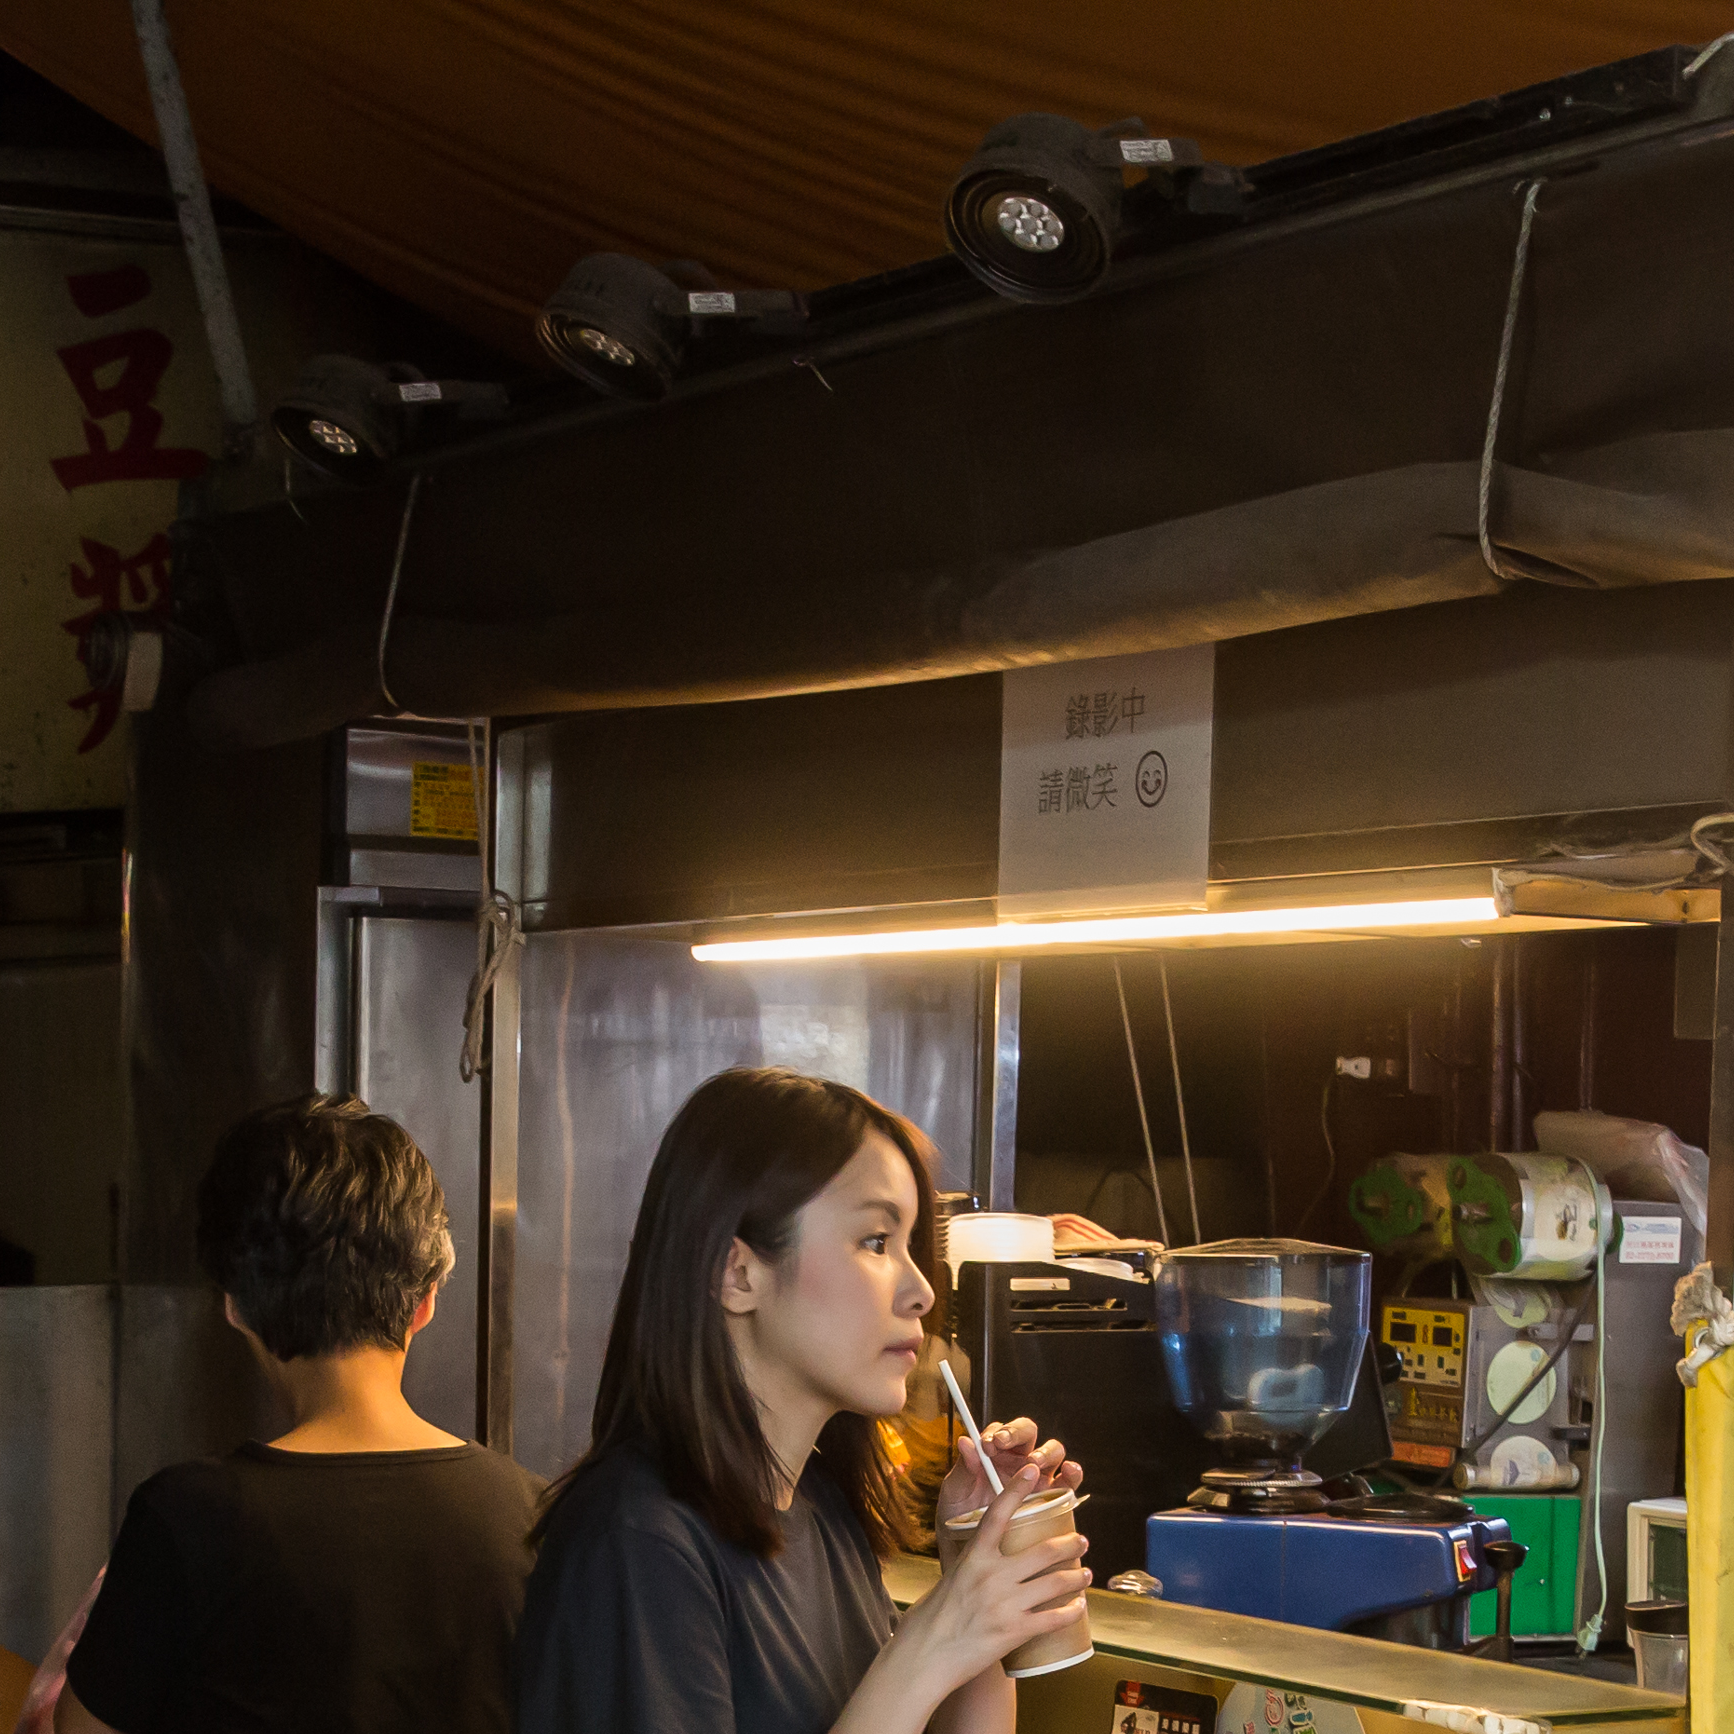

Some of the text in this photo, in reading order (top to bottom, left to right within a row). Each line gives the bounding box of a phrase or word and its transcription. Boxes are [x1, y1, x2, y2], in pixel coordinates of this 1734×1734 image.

[1065, 686, 1146, 740] 錄影中
[1038, 762, 1118, 814] 請微笑
